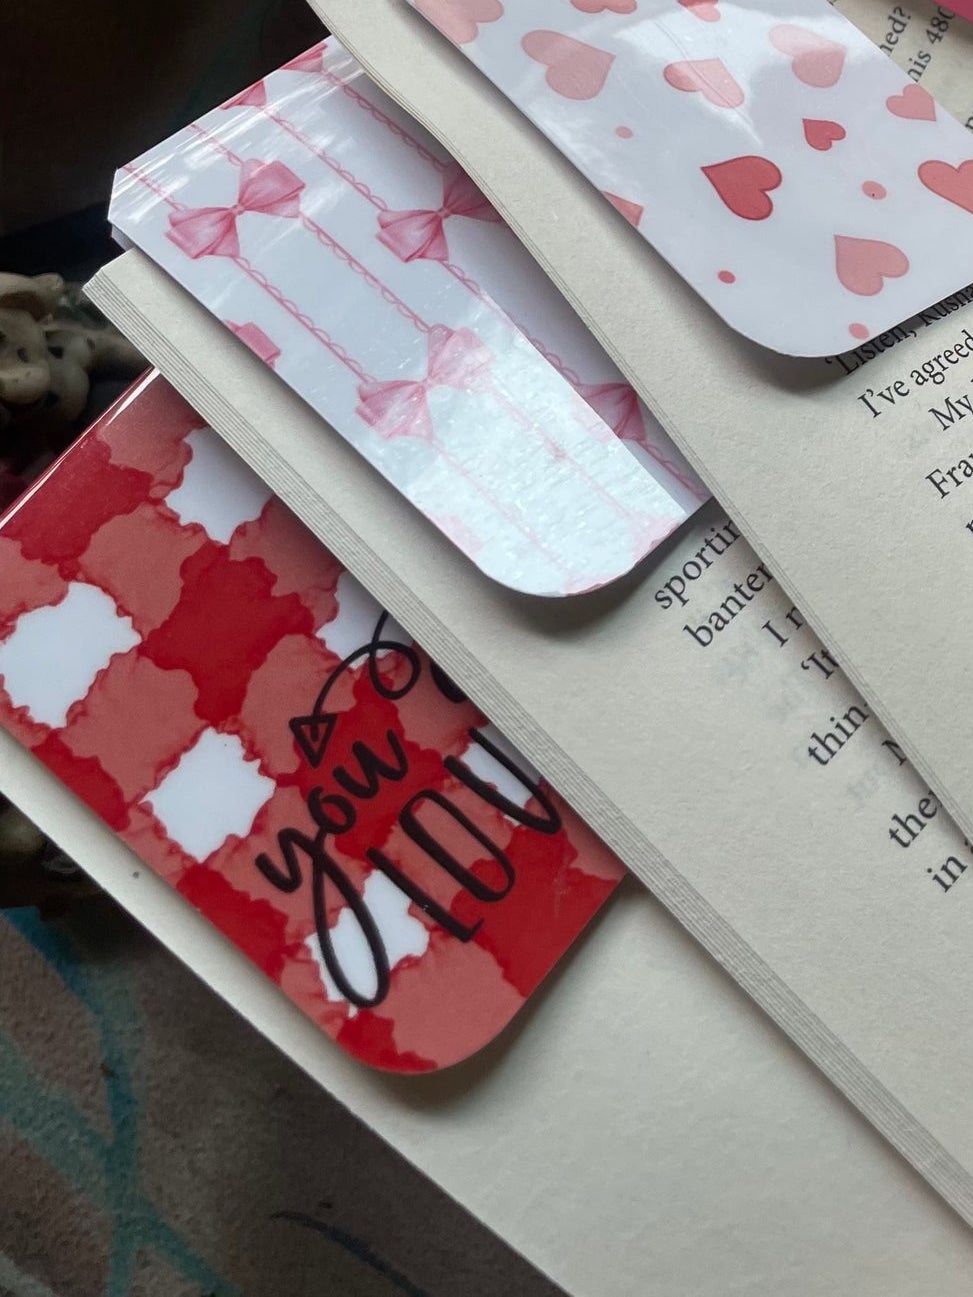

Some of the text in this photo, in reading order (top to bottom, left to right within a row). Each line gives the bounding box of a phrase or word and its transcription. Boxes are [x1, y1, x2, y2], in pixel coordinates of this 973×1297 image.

[683, 560, 774, 648] banter
[761, 619, 789, 648] I
[255, 729, 409, 1009] you
[365, 727, 562, 944] LOV
[926, 854, 968, 893] in
